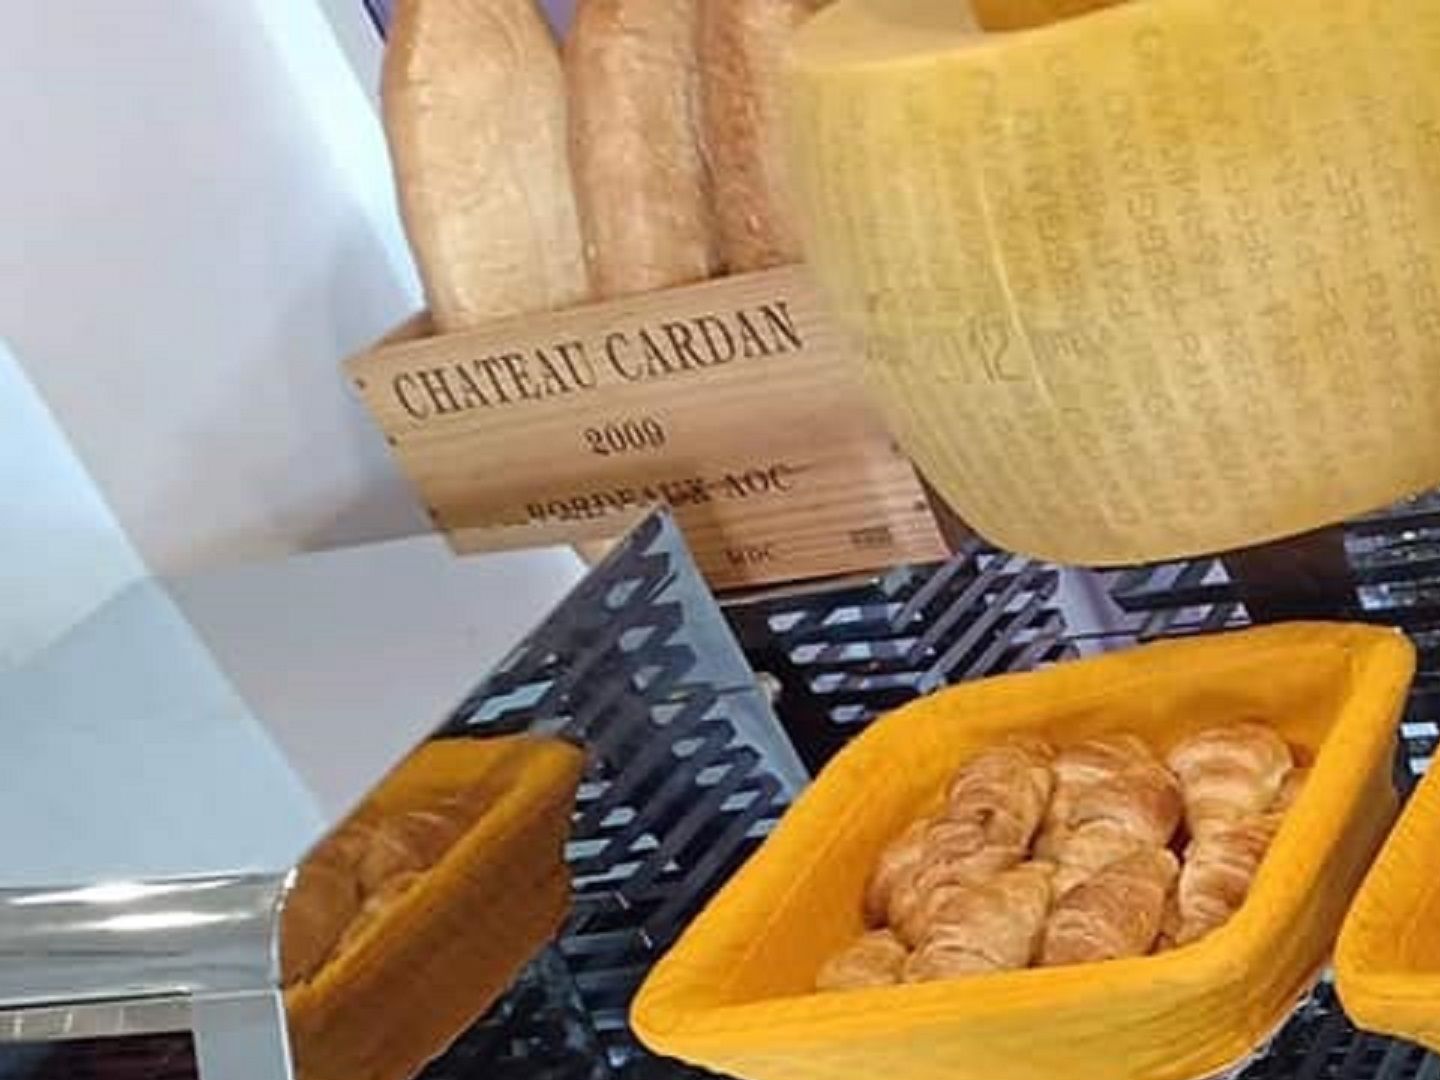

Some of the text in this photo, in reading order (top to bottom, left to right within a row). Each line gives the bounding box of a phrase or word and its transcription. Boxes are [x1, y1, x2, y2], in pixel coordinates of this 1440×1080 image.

[392, 301, 803, 421] CHATEAU CARDAN
[584, 420, 667, 456] 2009
